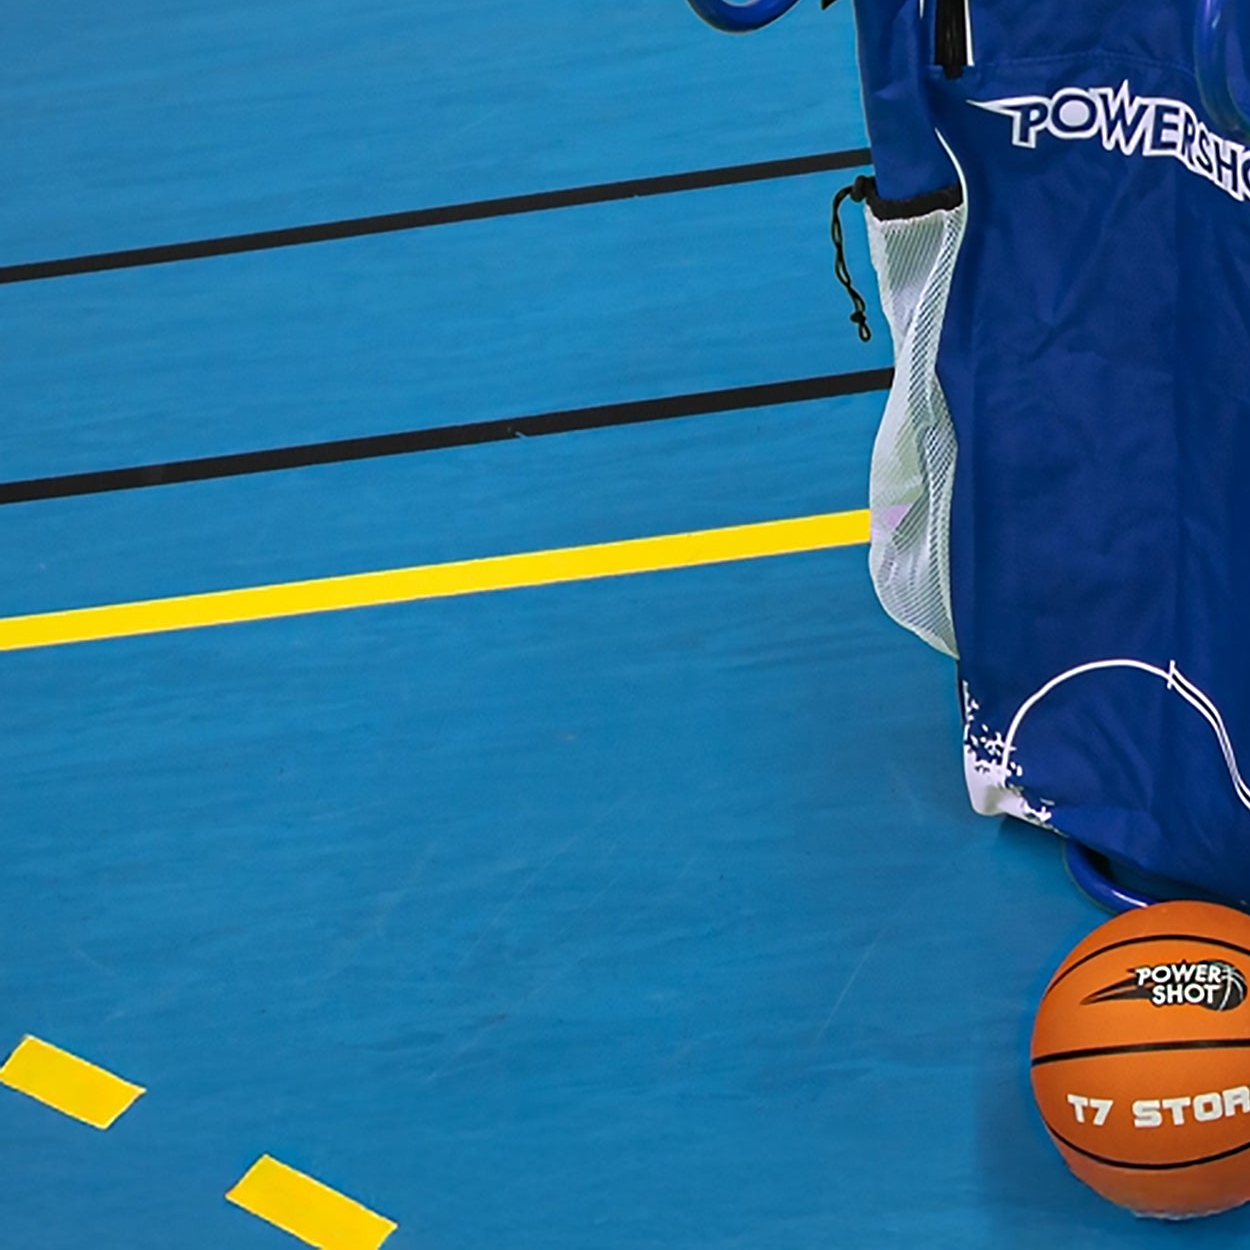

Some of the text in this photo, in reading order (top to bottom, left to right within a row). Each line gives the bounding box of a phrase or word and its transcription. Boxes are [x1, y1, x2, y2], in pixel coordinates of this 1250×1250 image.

[1136, 964, 1221, 986] POWER
[1152, 984, 1222, 1004] SHOT
[1066, 1093, 1114, 1127] T7
